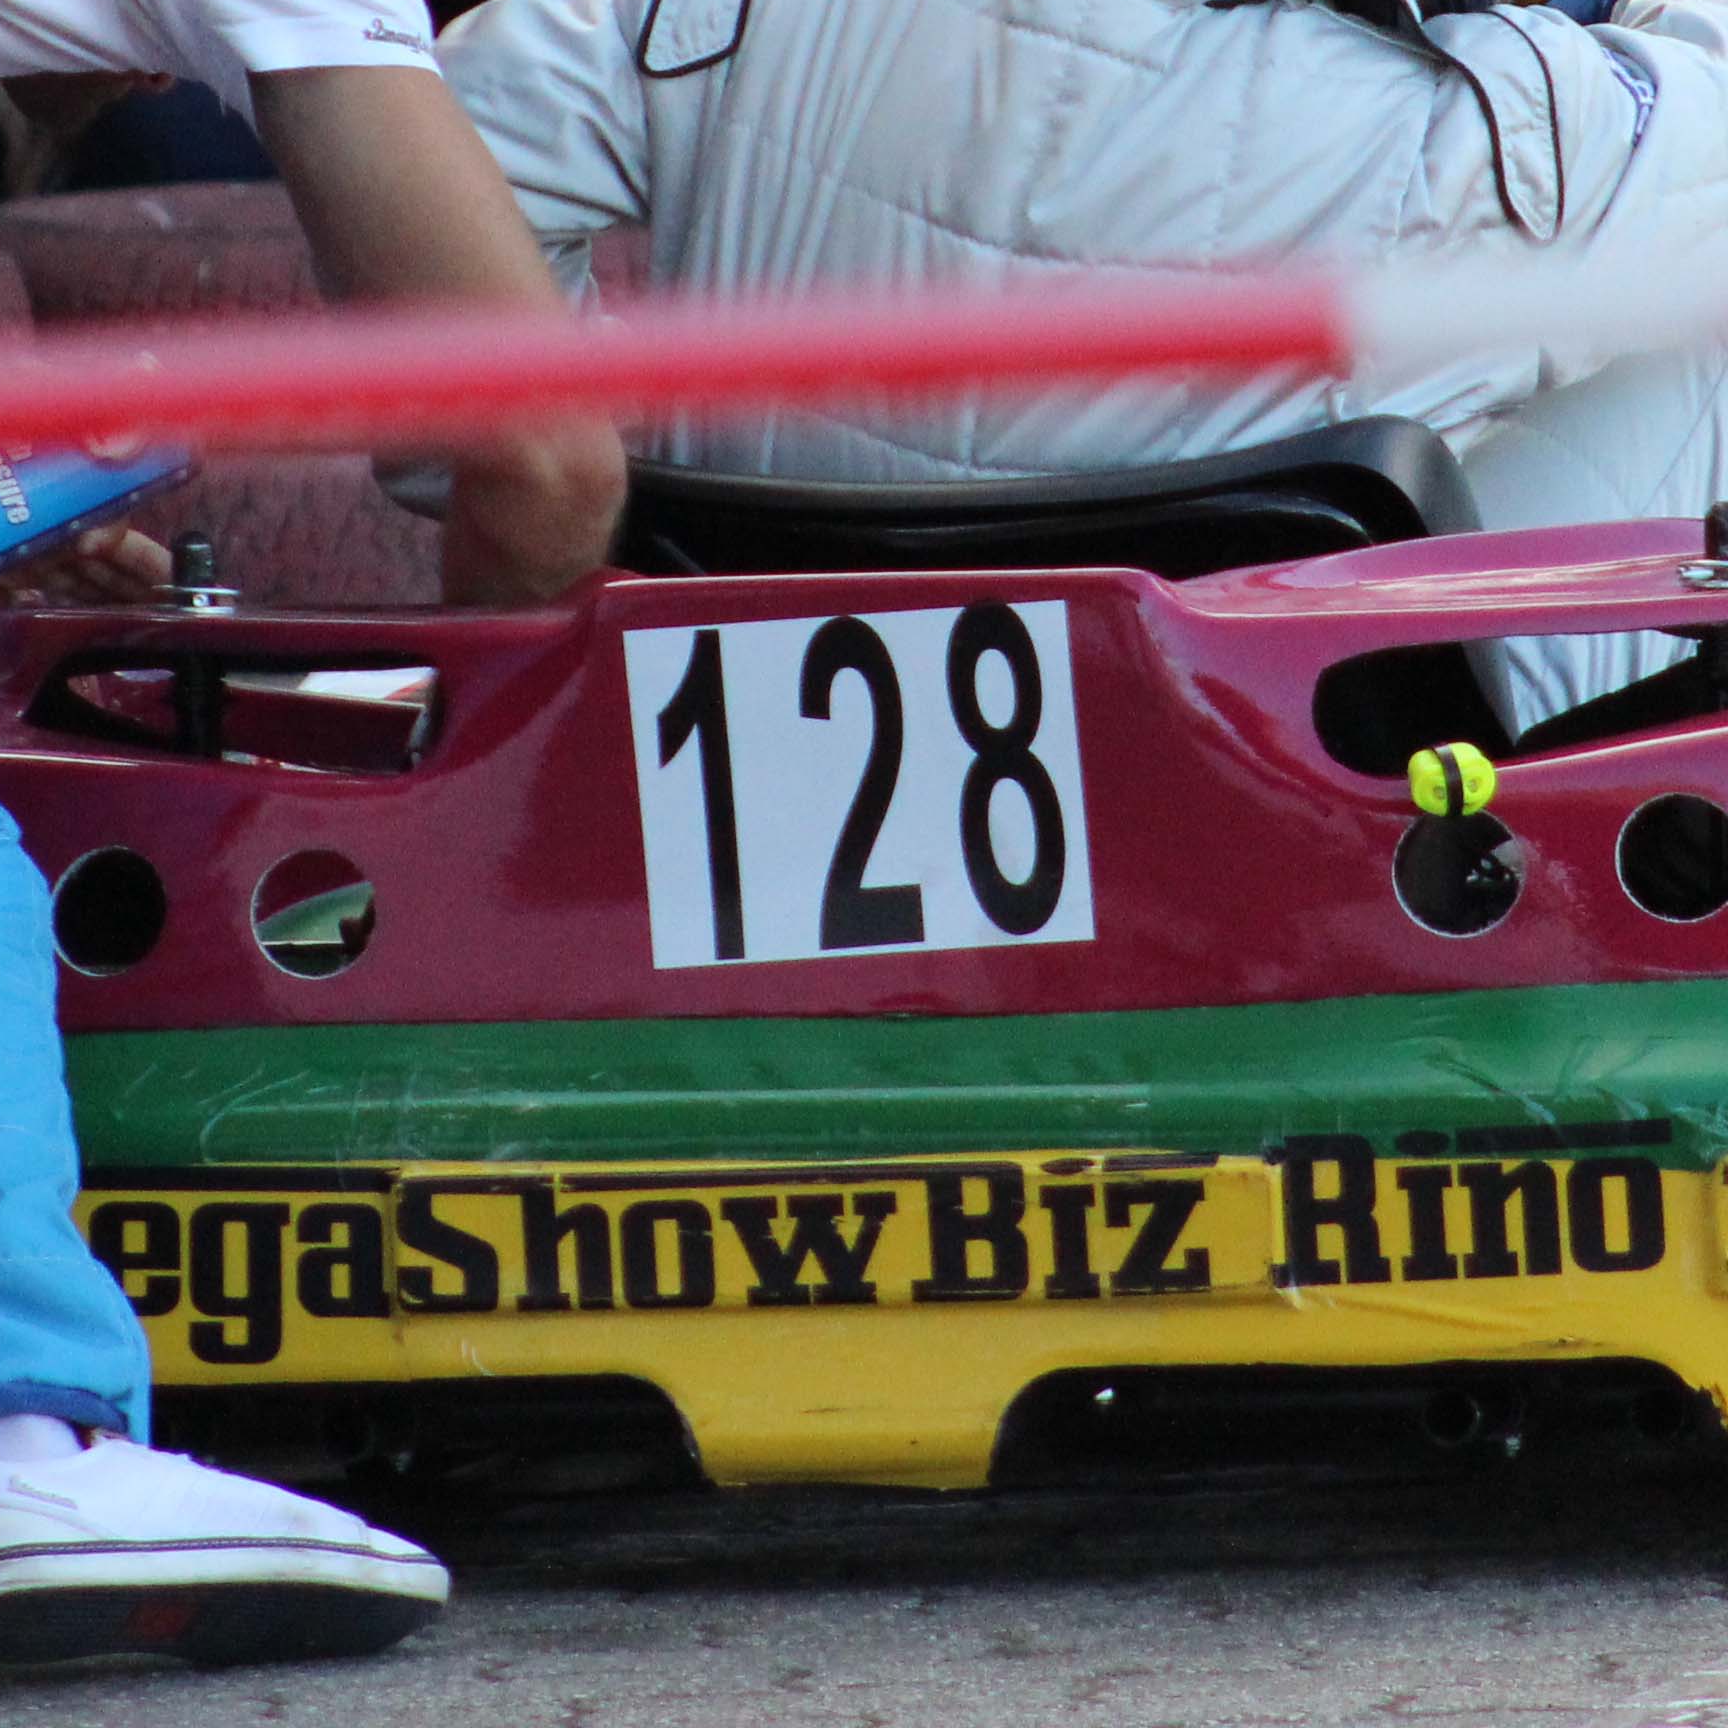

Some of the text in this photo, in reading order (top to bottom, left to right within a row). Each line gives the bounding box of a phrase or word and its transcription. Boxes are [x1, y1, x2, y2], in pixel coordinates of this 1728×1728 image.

[656, 600, 1066, 961] 128
[87, 1130, 1669, 1365] egaShowBiz Rino
